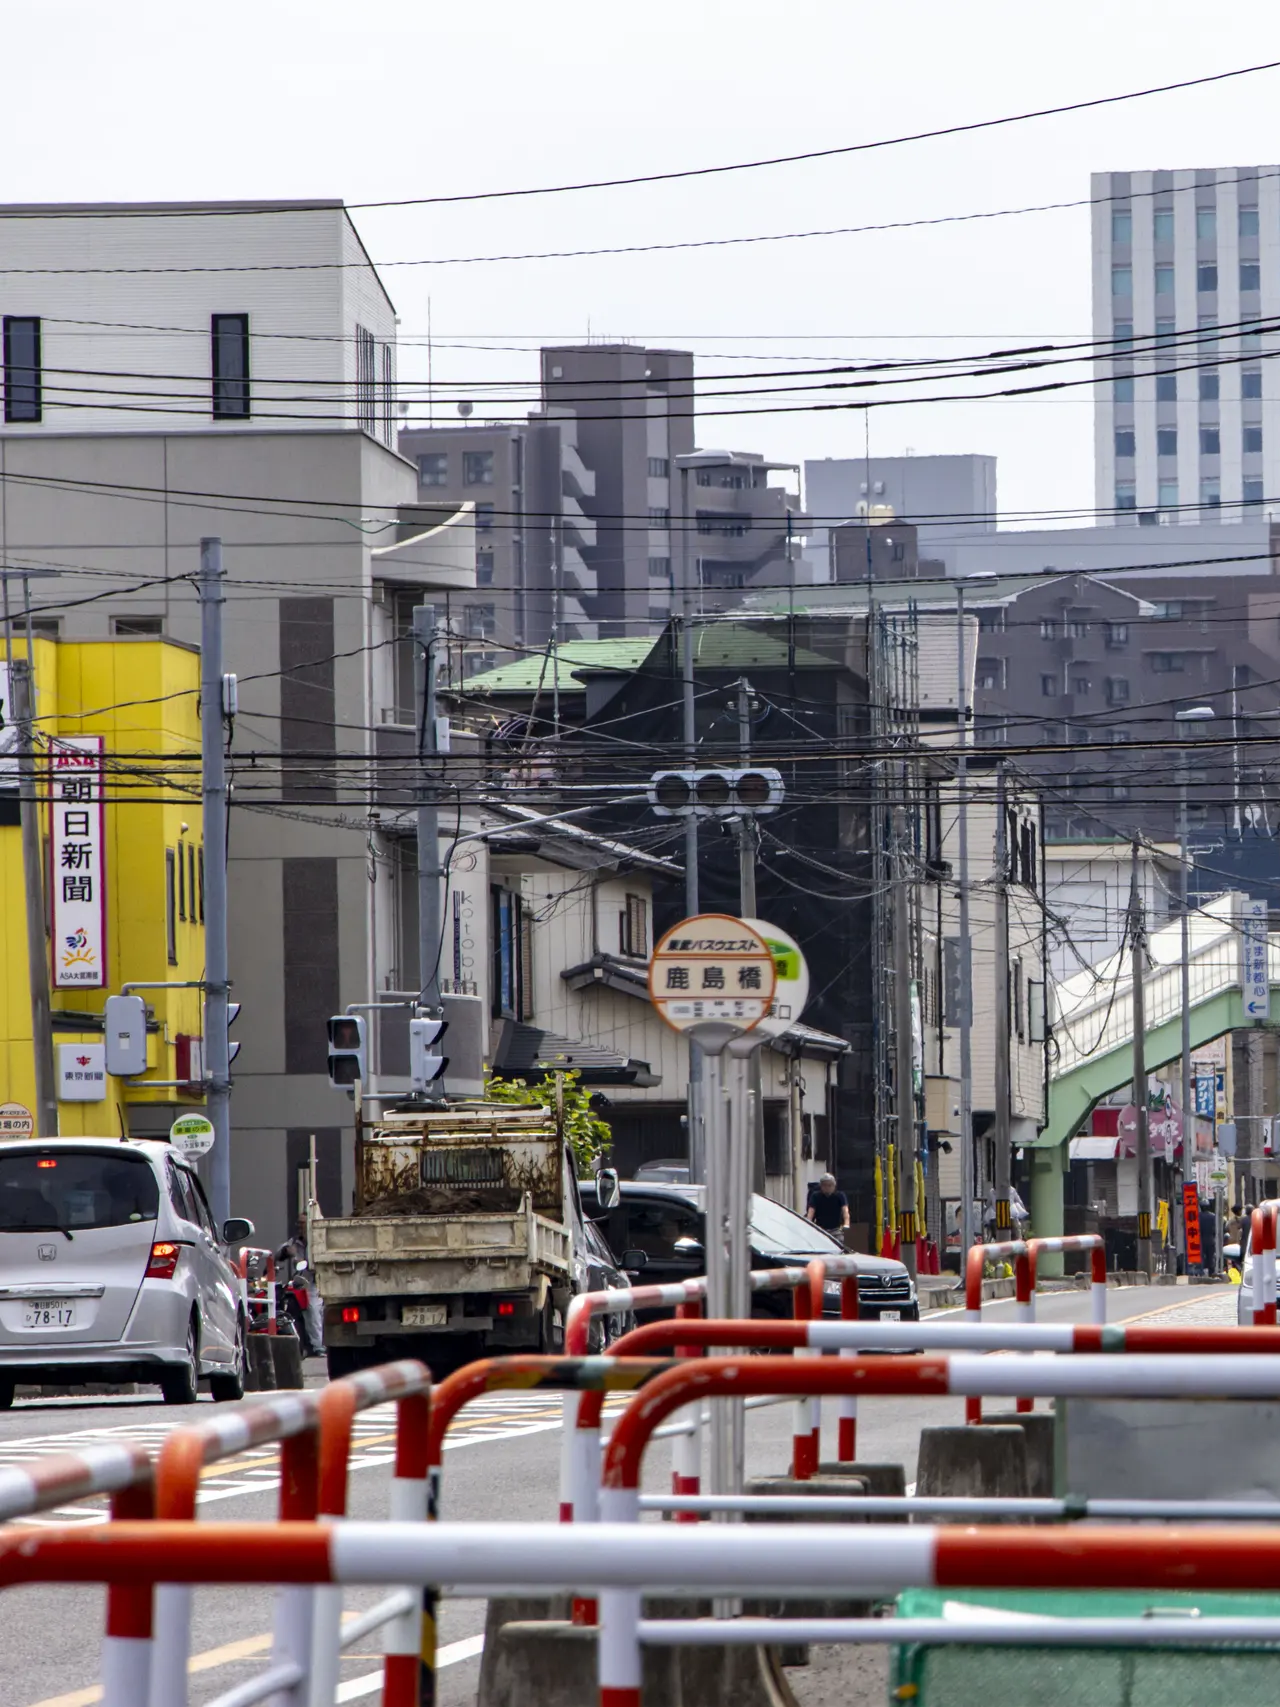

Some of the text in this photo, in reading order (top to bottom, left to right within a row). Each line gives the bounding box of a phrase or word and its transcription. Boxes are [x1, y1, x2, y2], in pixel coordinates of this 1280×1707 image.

[61, 777, 93, 903] 朝日新聞
[667, 939, 759, 951] 東武バスウエスト
[666, 966, 762, 990] 鹿島橋
[65, 1071, 104, 1081] 東京新聞
[33, 1309, 73, 1325] 78-17
